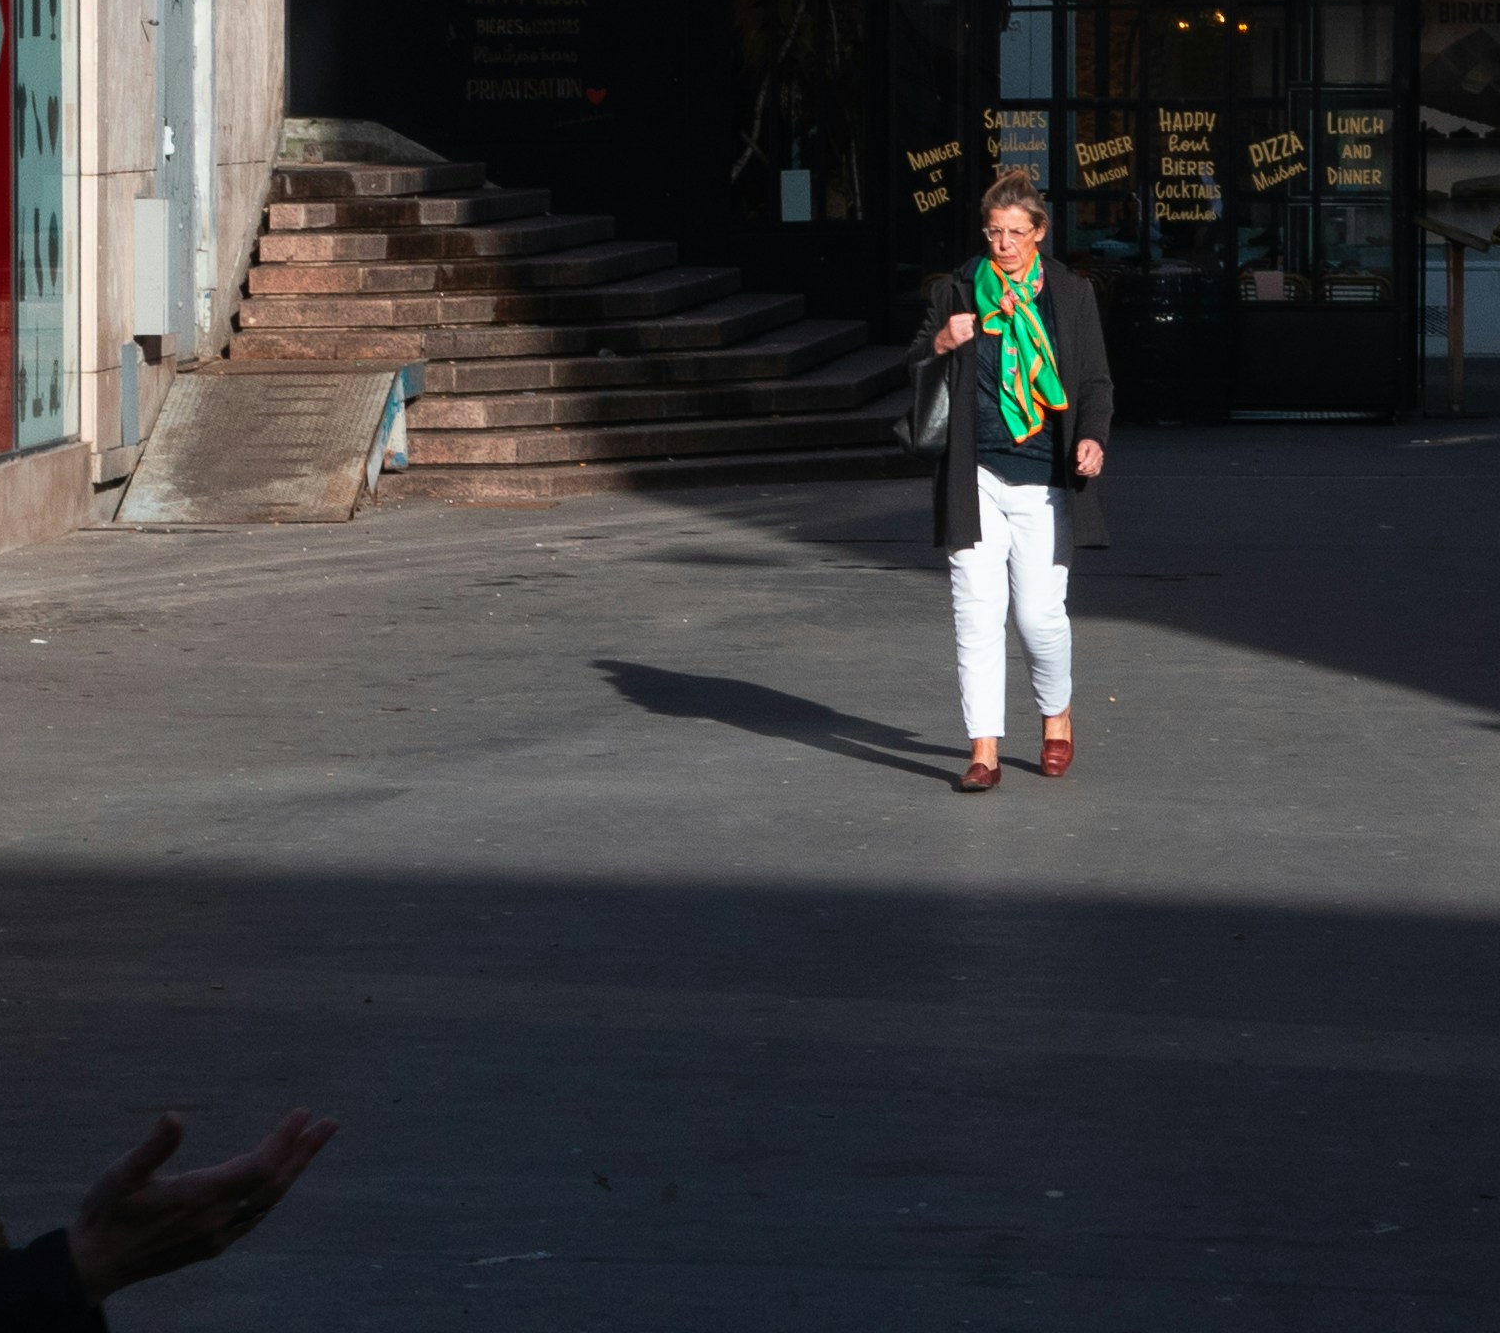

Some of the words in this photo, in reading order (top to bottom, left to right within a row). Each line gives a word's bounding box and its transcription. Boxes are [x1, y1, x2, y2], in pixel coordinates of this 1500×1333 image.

[466, 77, 583, 101] PRIVATISATION
[983, 108, 1047, 130] SALADES
[1158, 107, 1216, 132] HAPPY
[1327, 111, 1384, 134] LUNCH
[907, 141, 963, 172] MANGER
[1075, 136, 1134, 166] BURGER
[1342, 144, 1372, 159] AND
[930, 168, 943, 183] ET
[913, 187, 950, 213] BOIR
